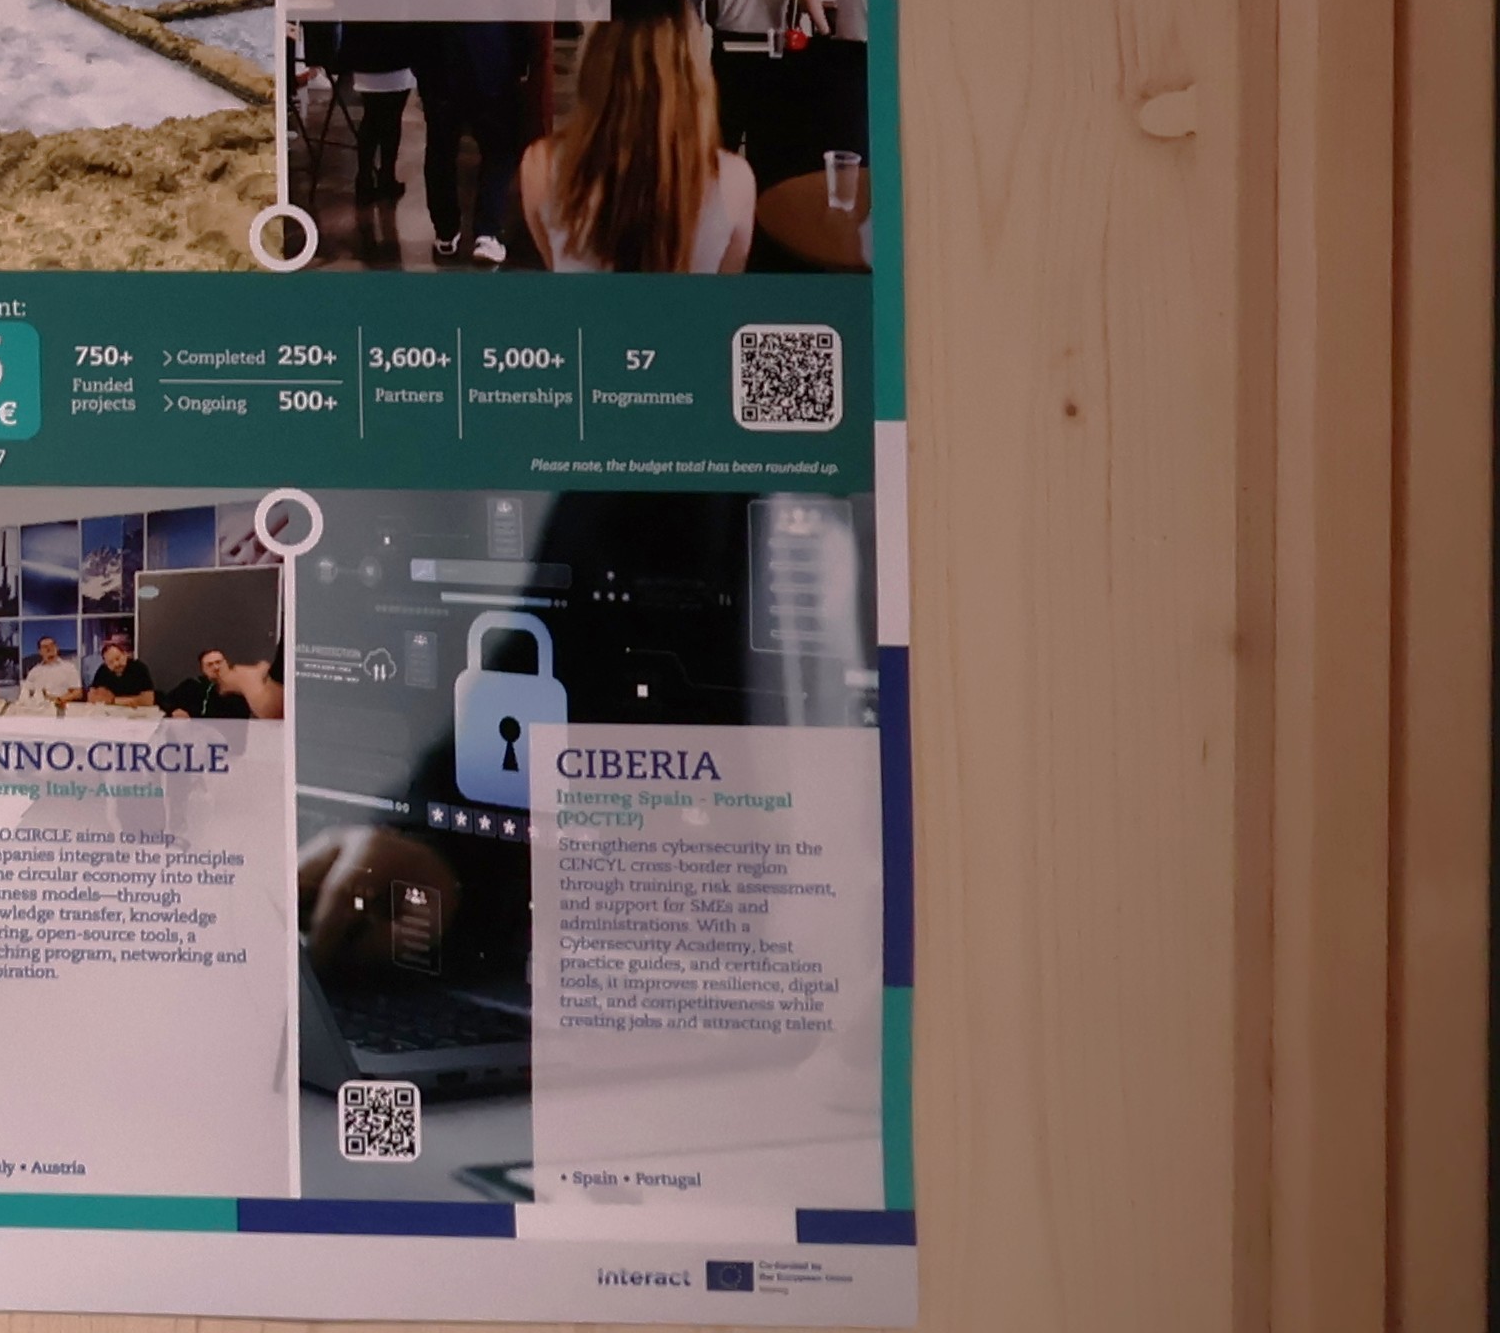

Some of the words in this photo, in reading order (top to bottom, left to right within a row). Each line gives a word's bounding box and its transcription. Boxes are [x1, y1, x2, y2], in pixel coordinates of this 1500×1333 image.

[74, 345, 133, 366] 750+
[277, 344, 337, 366] 250+
[368, 346, 451, 372] 3,600+
[483, 347, 565, 373] 5,000+
[626, 349, 656, 370] 57
[555, 746, 721, 781] CIBERIA
